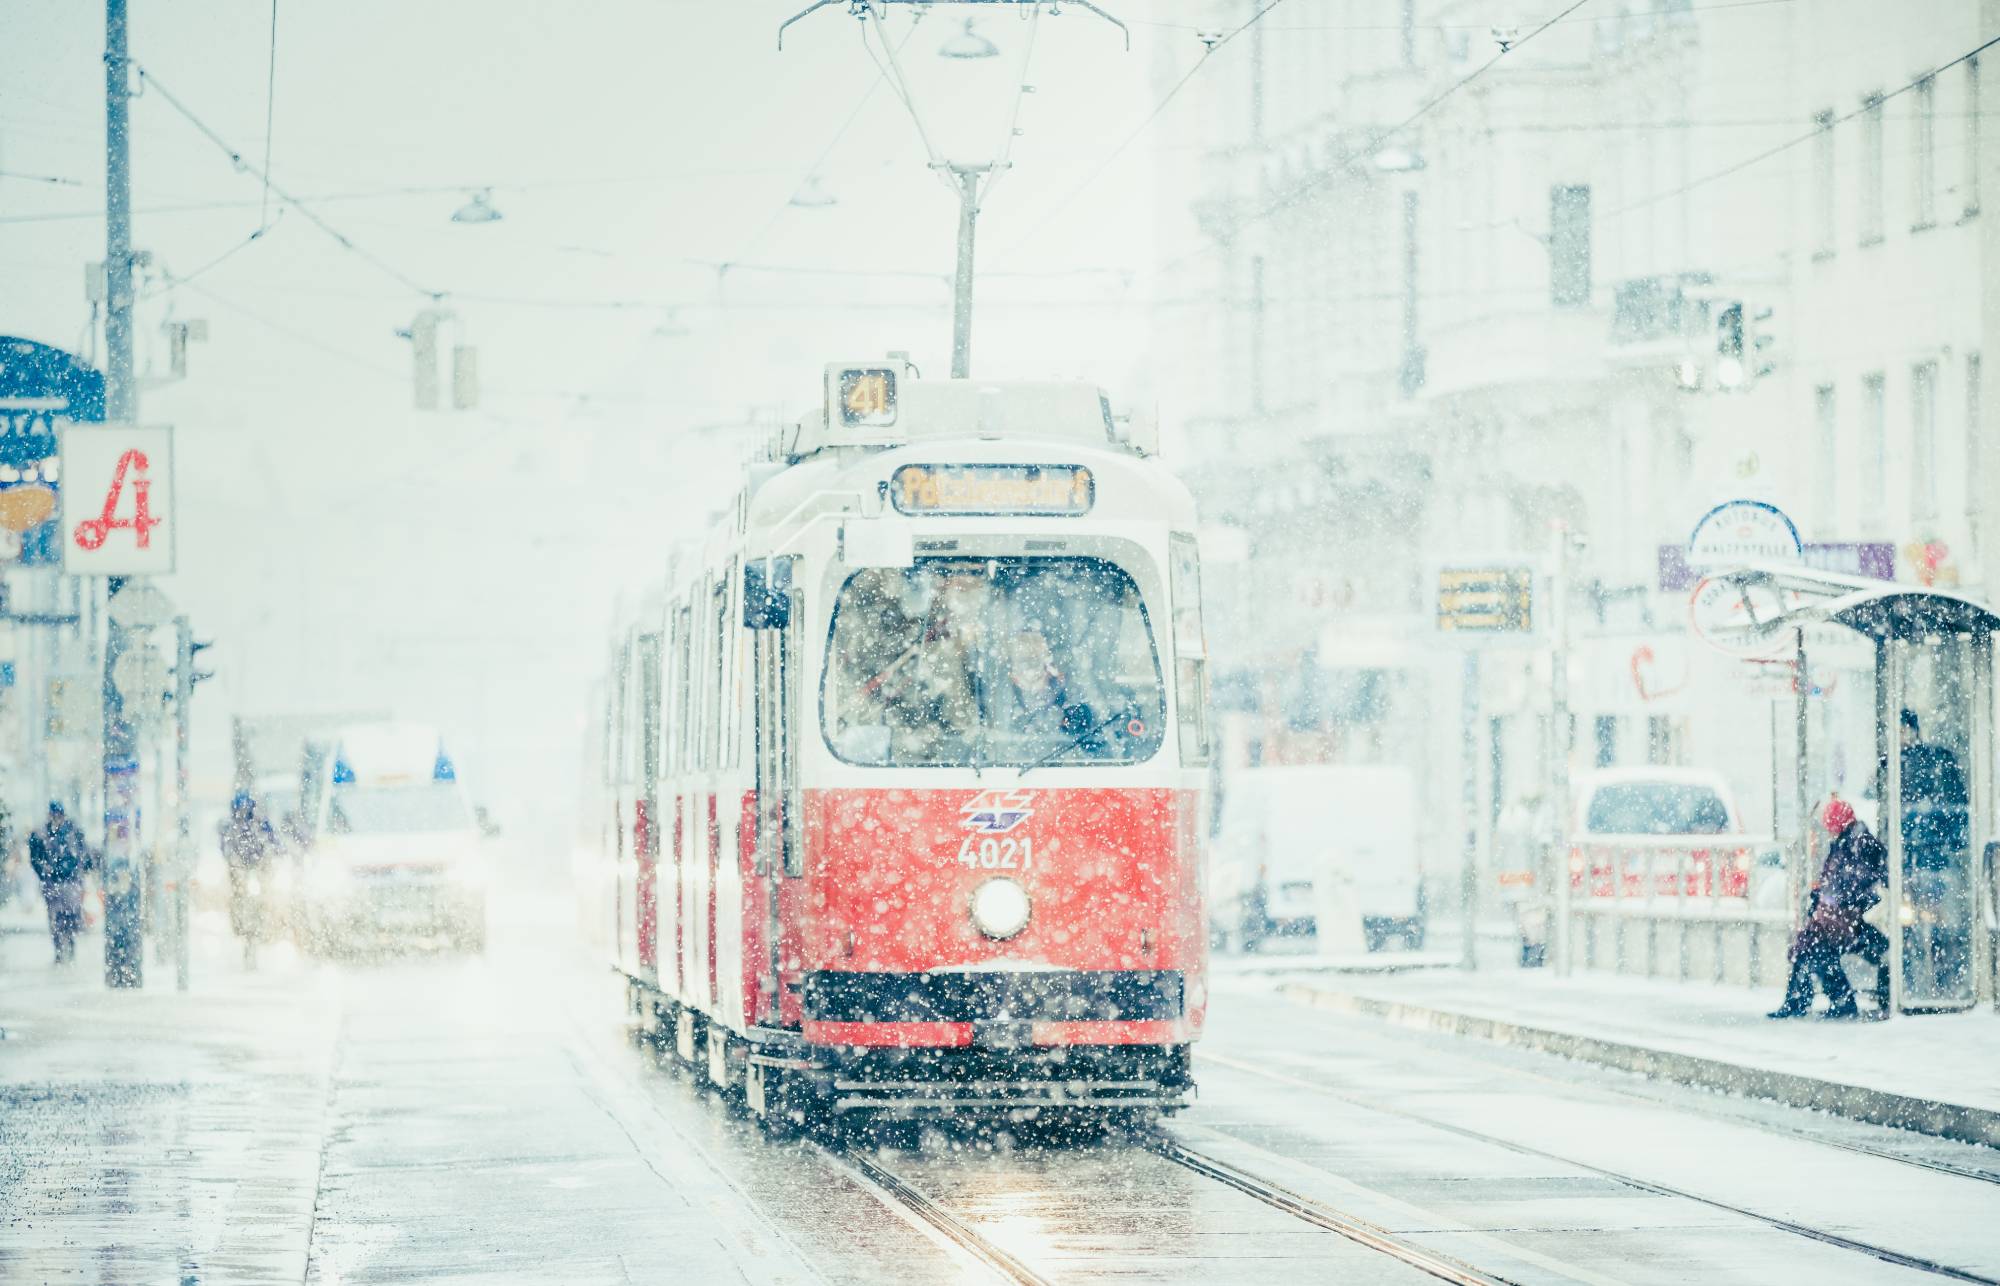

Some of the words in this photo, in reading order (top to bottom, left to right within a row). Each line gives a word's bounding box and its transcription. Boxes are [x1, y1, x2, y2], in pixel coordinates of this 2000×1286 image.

[848, 375, 886, 415] 41
[1714, 509, 1778, 532] AUTOBUS
[1702, 543, 1788, 556] HALTESTELLE
[958, 836, 1032, 869] 4021
